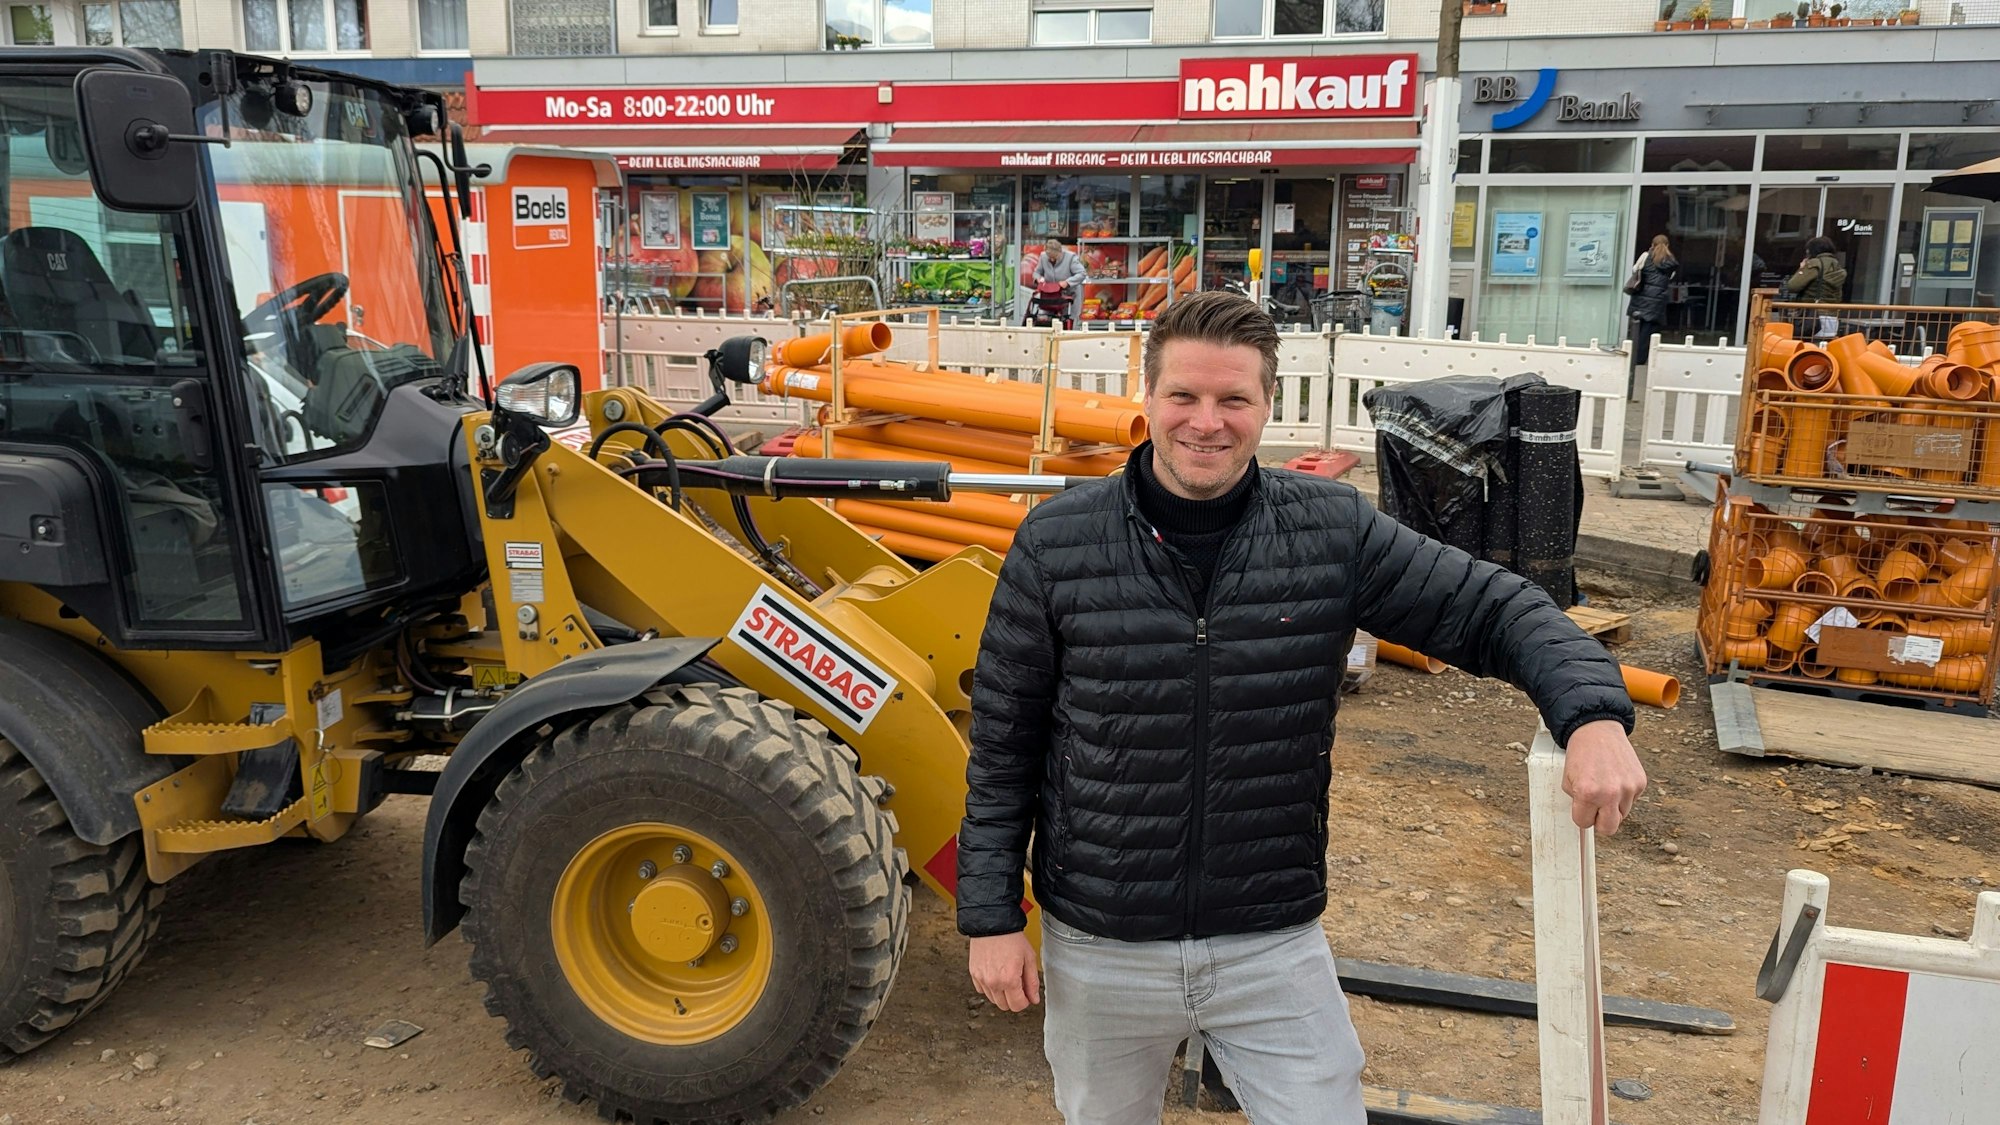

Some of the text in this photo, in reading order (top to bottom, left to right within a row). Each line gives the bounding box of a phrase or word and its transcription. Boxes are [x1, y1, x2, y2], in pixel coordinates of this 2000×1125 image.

[1184, 59, 1409, 112] nahkauf
[1472, 75, 1519, 103] BB
[345, 101, 370, 128] CAT
[545, 93, 775, 118] Mo-Sa 8:00-22:00 Uhr
[1556, 92, 1641, 122] Bank
[628, 156, 654, 169] DEIN
[655, 155, 761, 169] LIEBLINGSNACHBAR
[1001, 152, 1053, 166] nahkauf
[1054, 152, 1107, 166] IRRGANG
[1120, 152, 1149, 166] DEIN
[1150, 150, 1273, 165] LIEBLINGSNACHBAR
[515, 193, 566, 219] Boels
[46, 252, 68, 271] CAT
[744, 606, 877, 710] STRABAG
